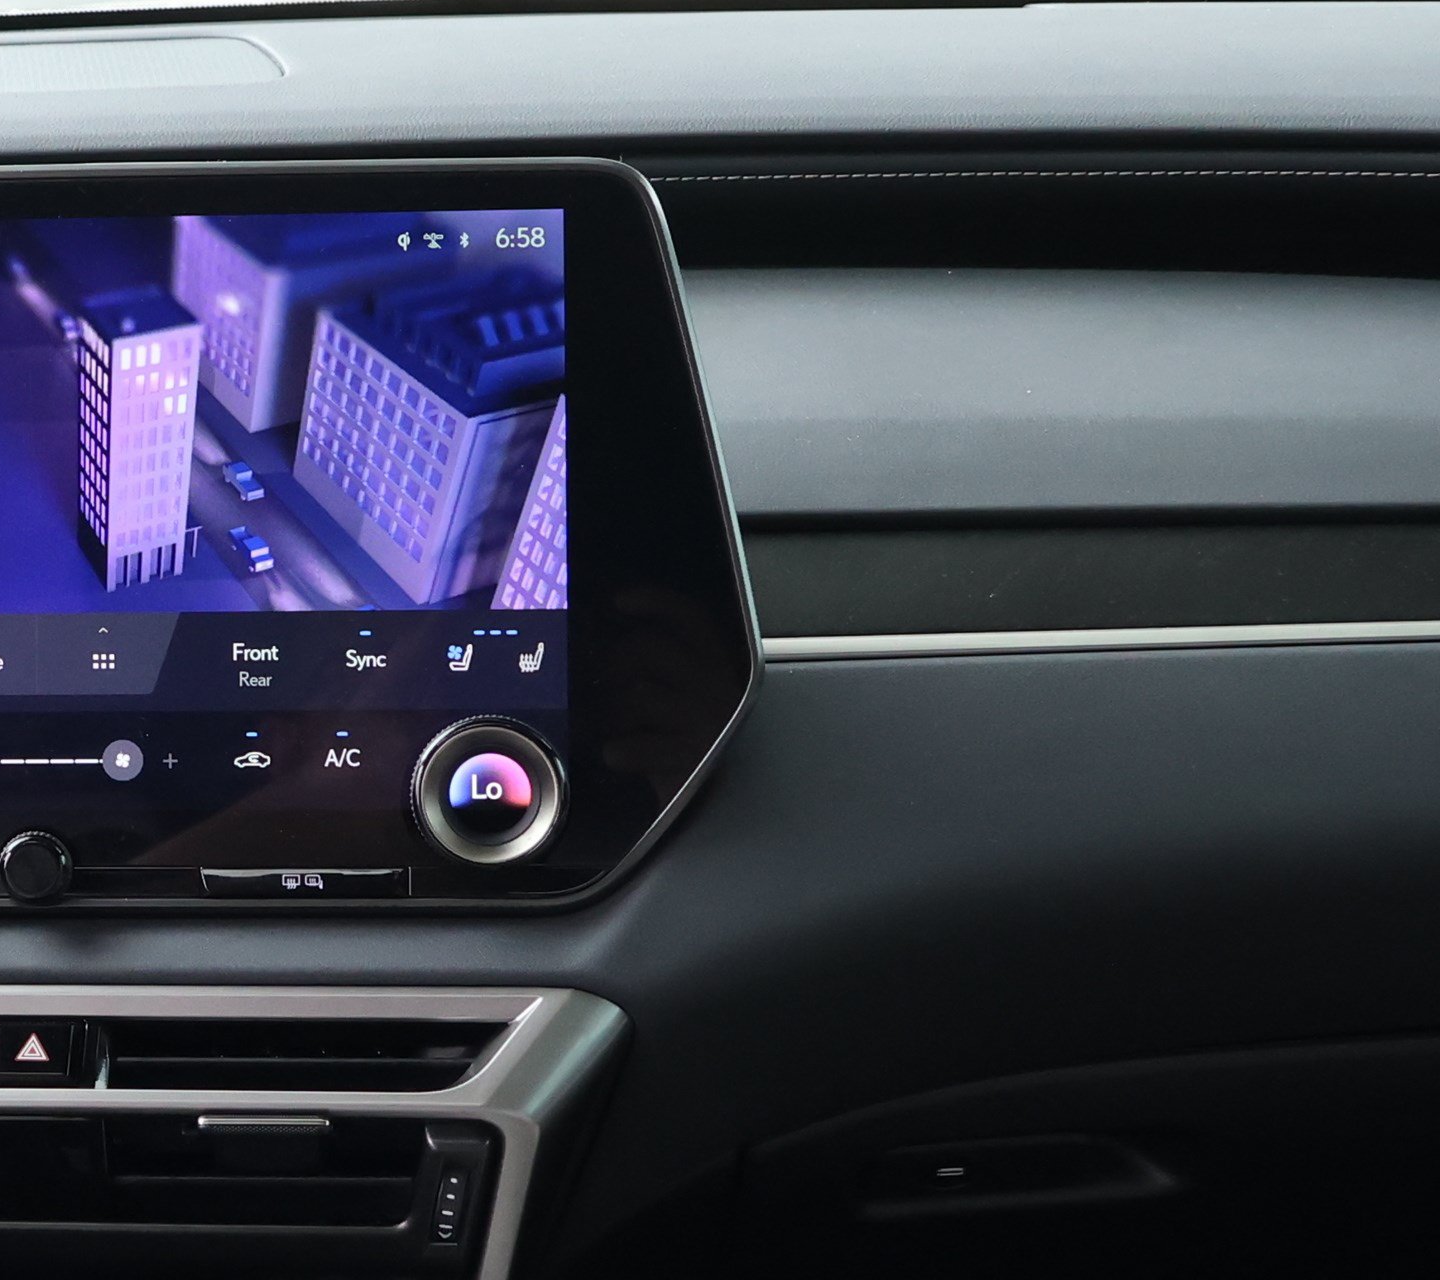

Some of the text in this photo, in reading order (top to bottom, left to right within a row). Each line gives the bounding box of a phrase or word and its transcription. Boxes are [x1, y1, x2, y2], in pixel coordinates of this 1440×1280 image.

[495, 227, 546, 249] 6:58
[232, 643, 279, 662] Front
[345, 651, 387, 671] Sync
[238, 671, 273, 687] Rear
[324, 748, 361, 769] A/C
[470, 774, 503, 800] Lo
